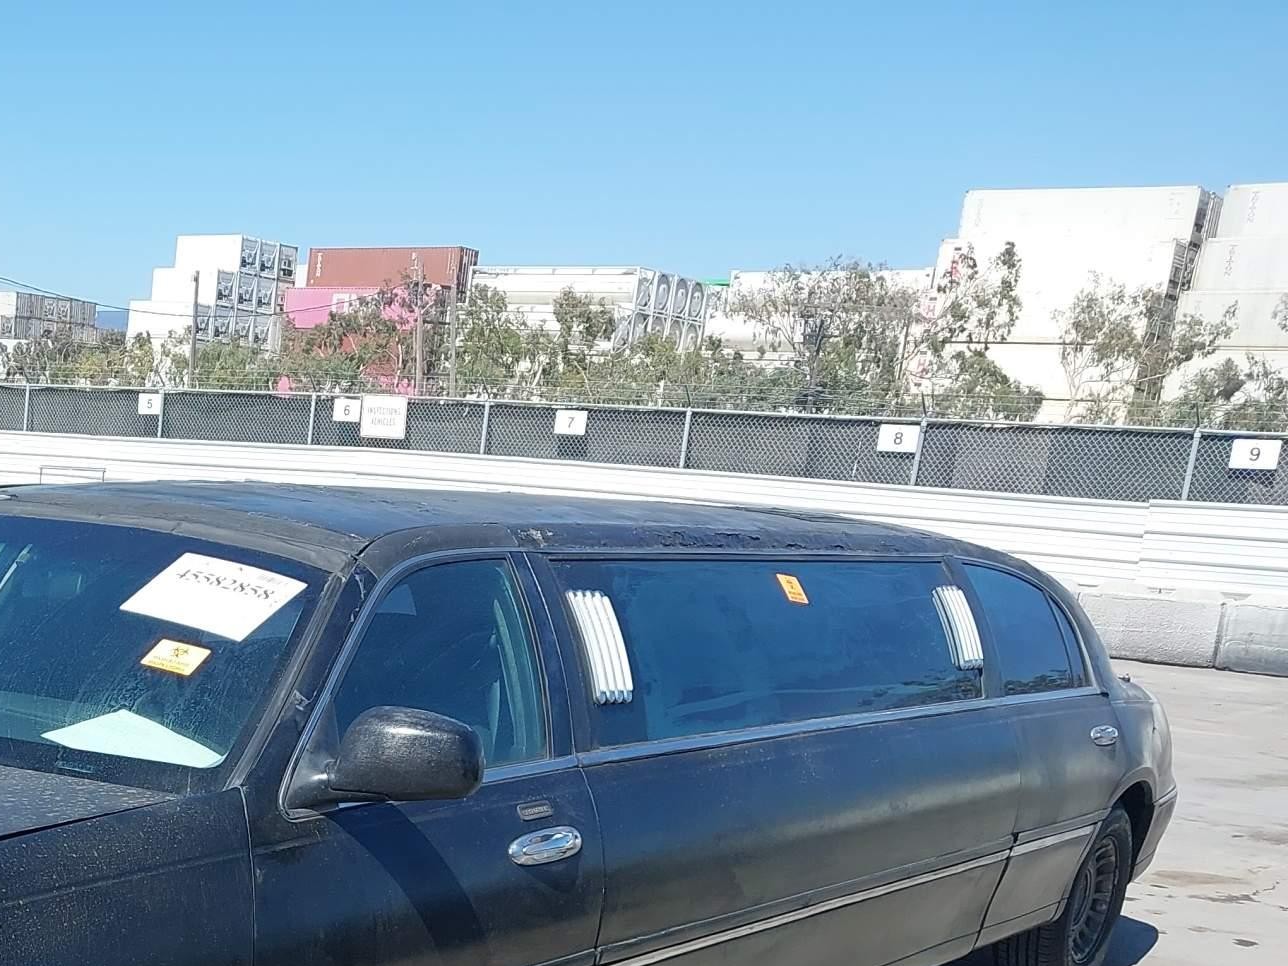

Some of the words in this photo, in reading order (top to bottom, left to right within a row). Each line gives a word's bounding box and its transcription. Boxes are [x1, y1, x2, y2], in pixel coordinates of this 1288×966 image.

[146, 398, 154, 410] 5
[343, 405, 352, 417] 6
[567, 416, 576, 429] 7
[893, 431, 904, 445] 8
[1248, 446, 1261, 462] 9
[176, 569, 275, 600] 45582858
